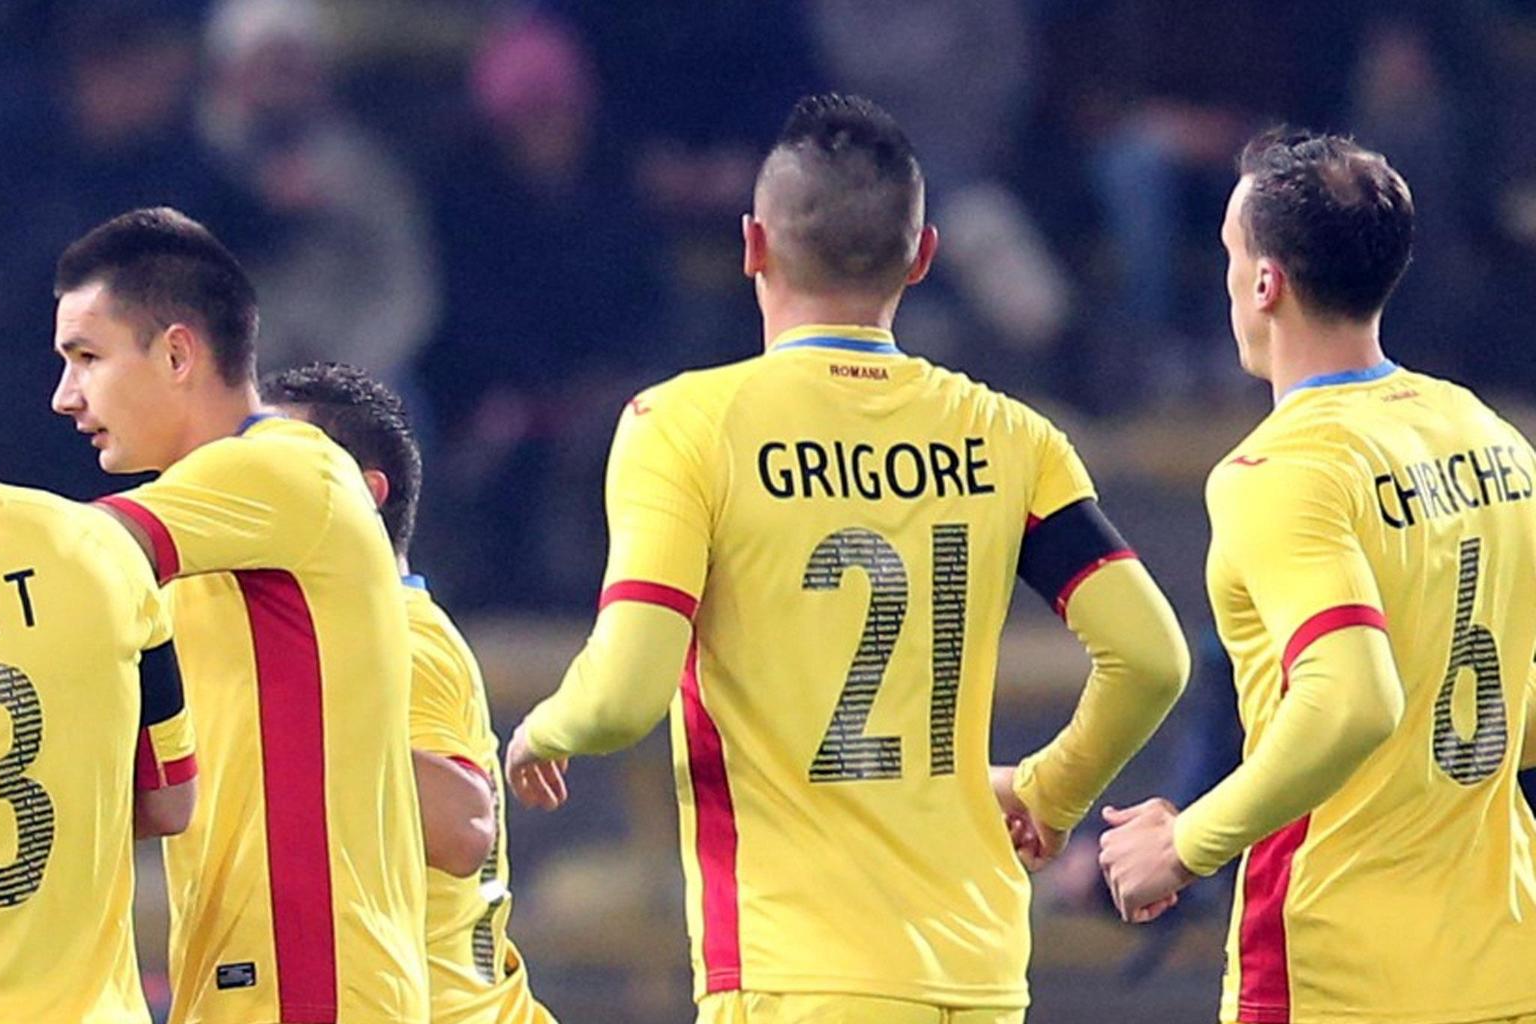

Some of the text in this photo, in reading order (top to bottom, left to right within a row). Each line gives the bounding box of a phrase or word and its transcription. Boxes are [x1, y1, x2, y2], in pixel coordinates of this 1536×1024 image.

[830, 364, 889, 380] ROMANIA
[758, 437, 996, 500] GRIGORE
[1375, 445, 1533, 529] CHIRICHES
[802, 523, 969, 783] 21
[1432, 537, 1509, 787] 6
